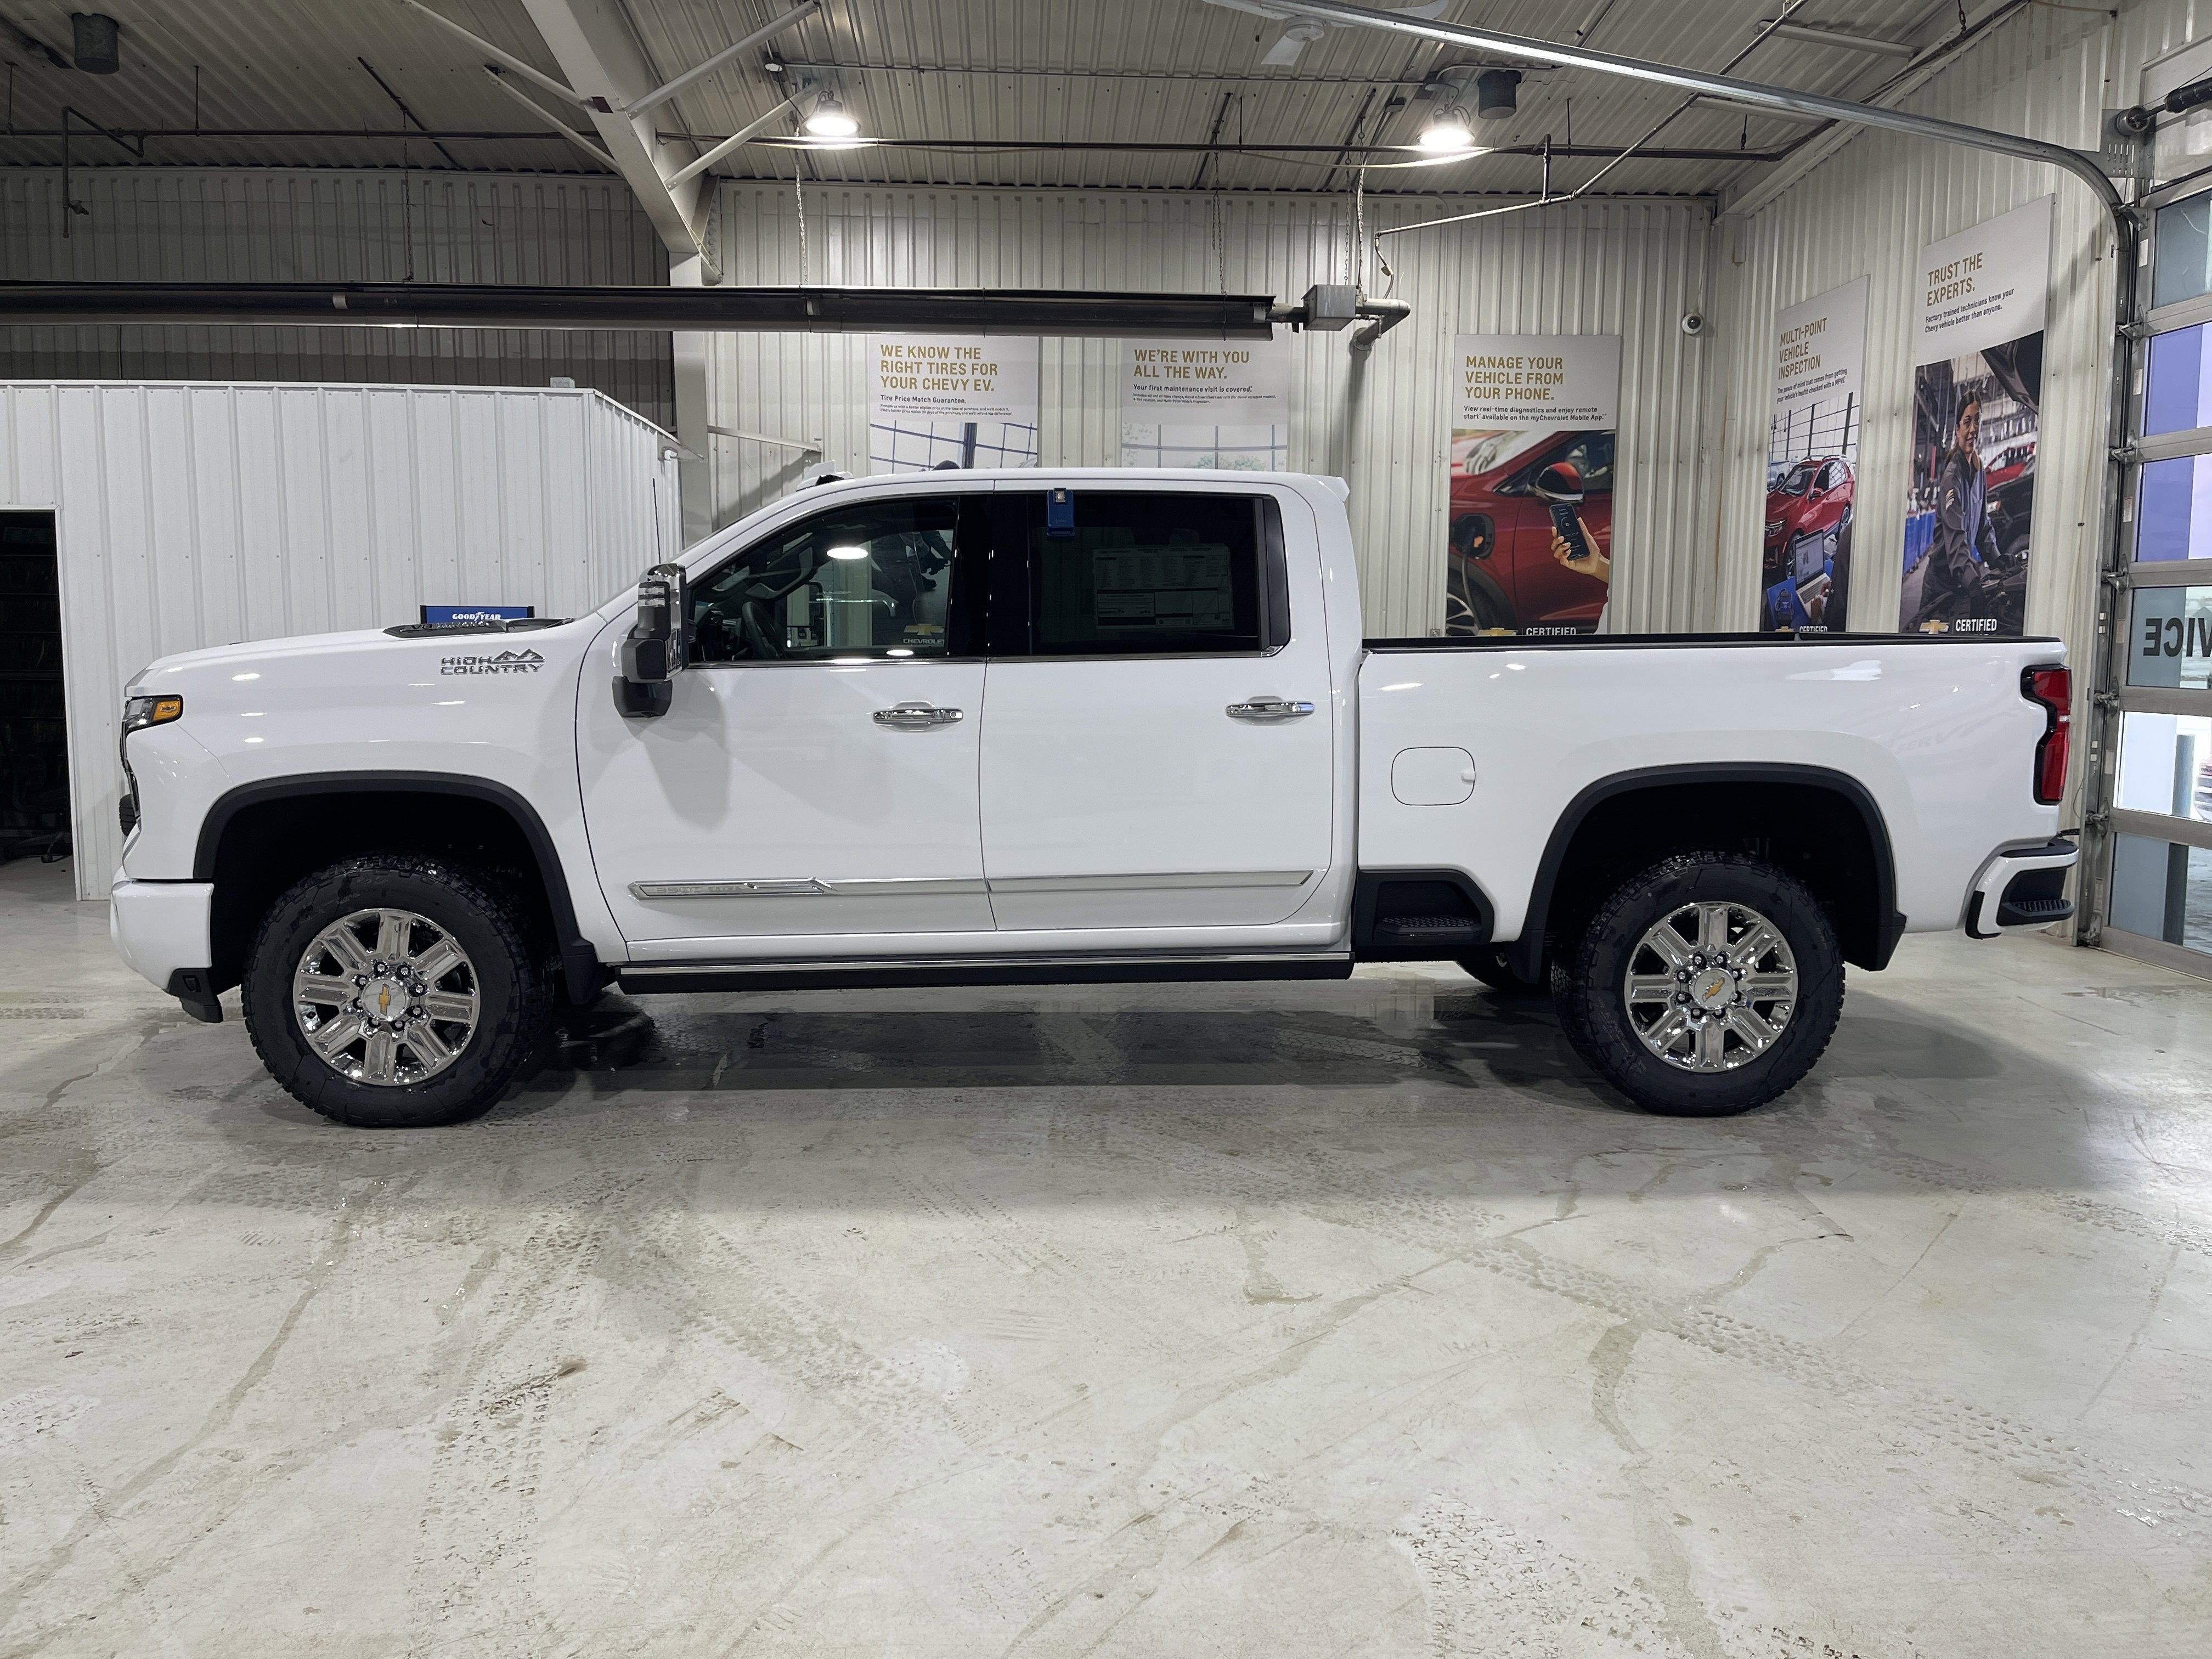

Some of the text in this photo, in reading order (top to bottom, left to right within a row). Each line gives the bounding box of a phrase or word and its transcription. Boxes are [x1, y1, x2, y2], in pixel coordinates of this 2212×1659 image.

[1928, 252, 1983, 286] TRUST THE
[1927, 277, 1975, 307] EXPERTS.
[1925, 289, 2015, 324] Factory trained technicians know your
[1925, 303, 2002, 333] Chevy vehicle better than anyone.
[1780, 317, 1827, 347] MULTI-POINT
[881, 345, 981, 359] WE KNOW THE
[1134, 349, 1249, 364] WE'RE WITH YOU
[1779, 341, 1809, 363] VEHICLE
[881, 360, 997, 376] RIGHT TIRES FOR
[1466, 356, 1563, 369] MANAGE YOUR
[1778, 354, 1821, 380] INSPECTION
[1133, 365, 1227, 379] ALL THE WAY.
[1465, 371, 1564, 385] VEHICLE FROM
[1797, 380, 1805, 388] mind
[1835, 368, 1848, 379] getting
[881, 376, 994, 391] YOUR CHEVY EV.
[1465, 387, 1554, 400] YOUR PHONE.
[1785, 391, 1798, 400] vehicle's
[1809, 383, 1823, 393] checked
[452, 612, 501, 621] GOODYEAR
[1526, 627, 1576, 635] CERTIFIED
[1956, 619, 1997, 631] CERTIFIED
[441, 656, 492, 665] HIGH
[441, 664, 544, 675] COUNTRY
